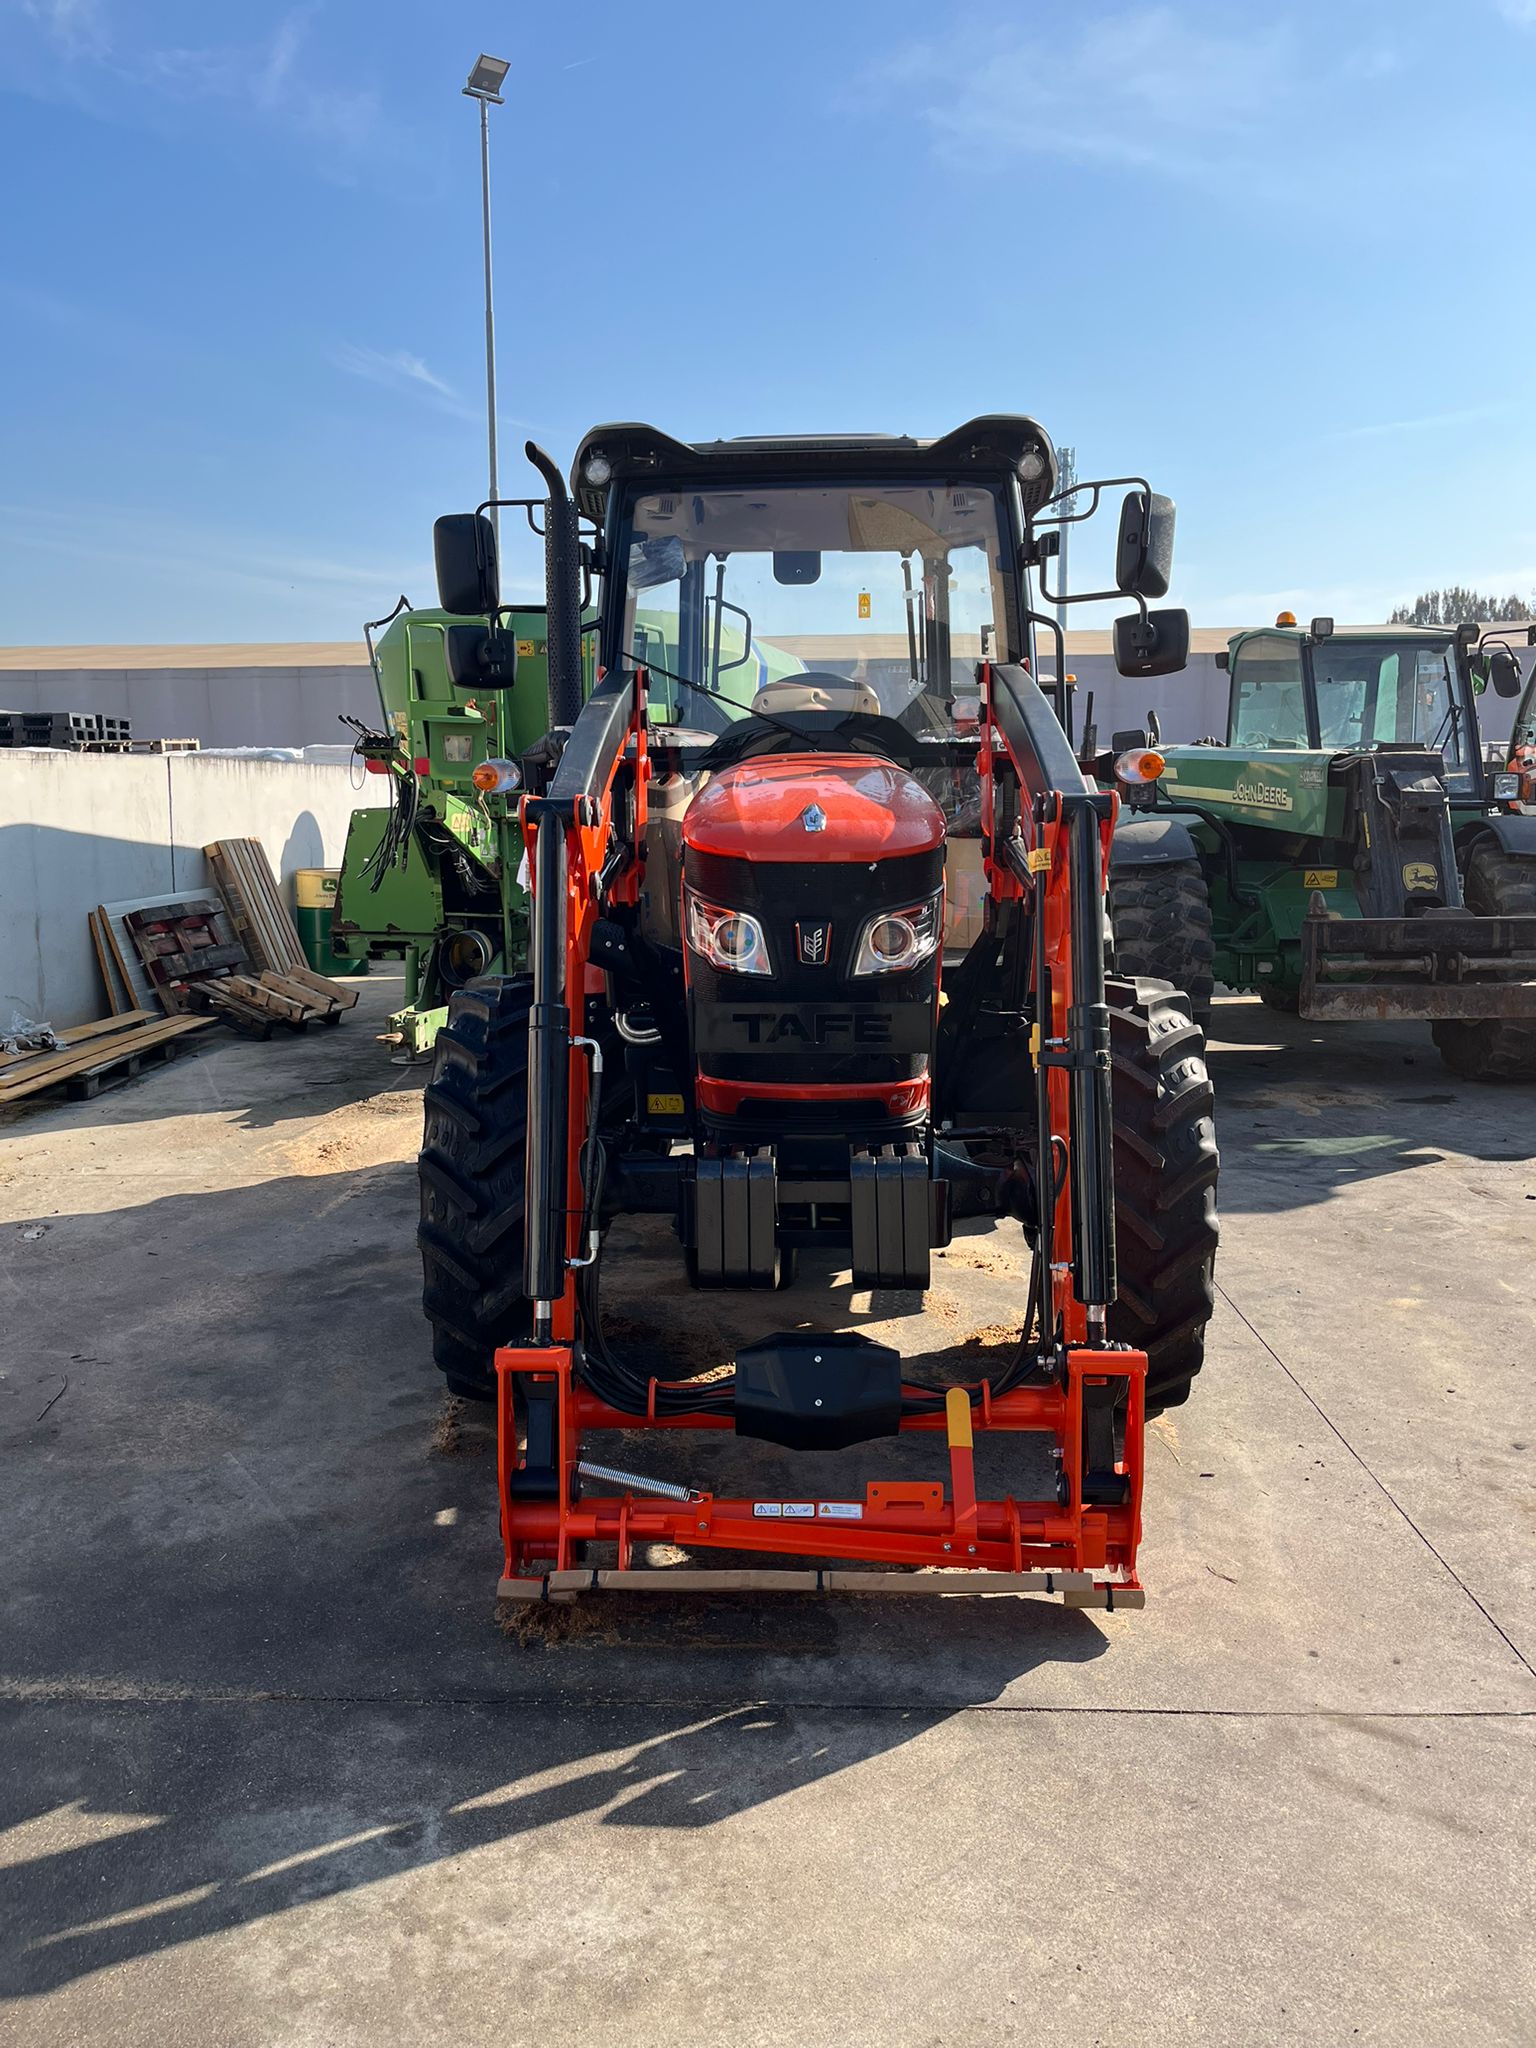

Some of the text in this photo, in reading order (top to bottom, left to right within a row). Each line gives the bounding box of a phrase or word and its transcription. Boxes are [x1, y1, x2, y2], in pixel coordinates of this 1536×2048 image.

[1232, 779, 1288, 806] JOHN DEERE
[732, 1013, 893, 1043] TAFE
